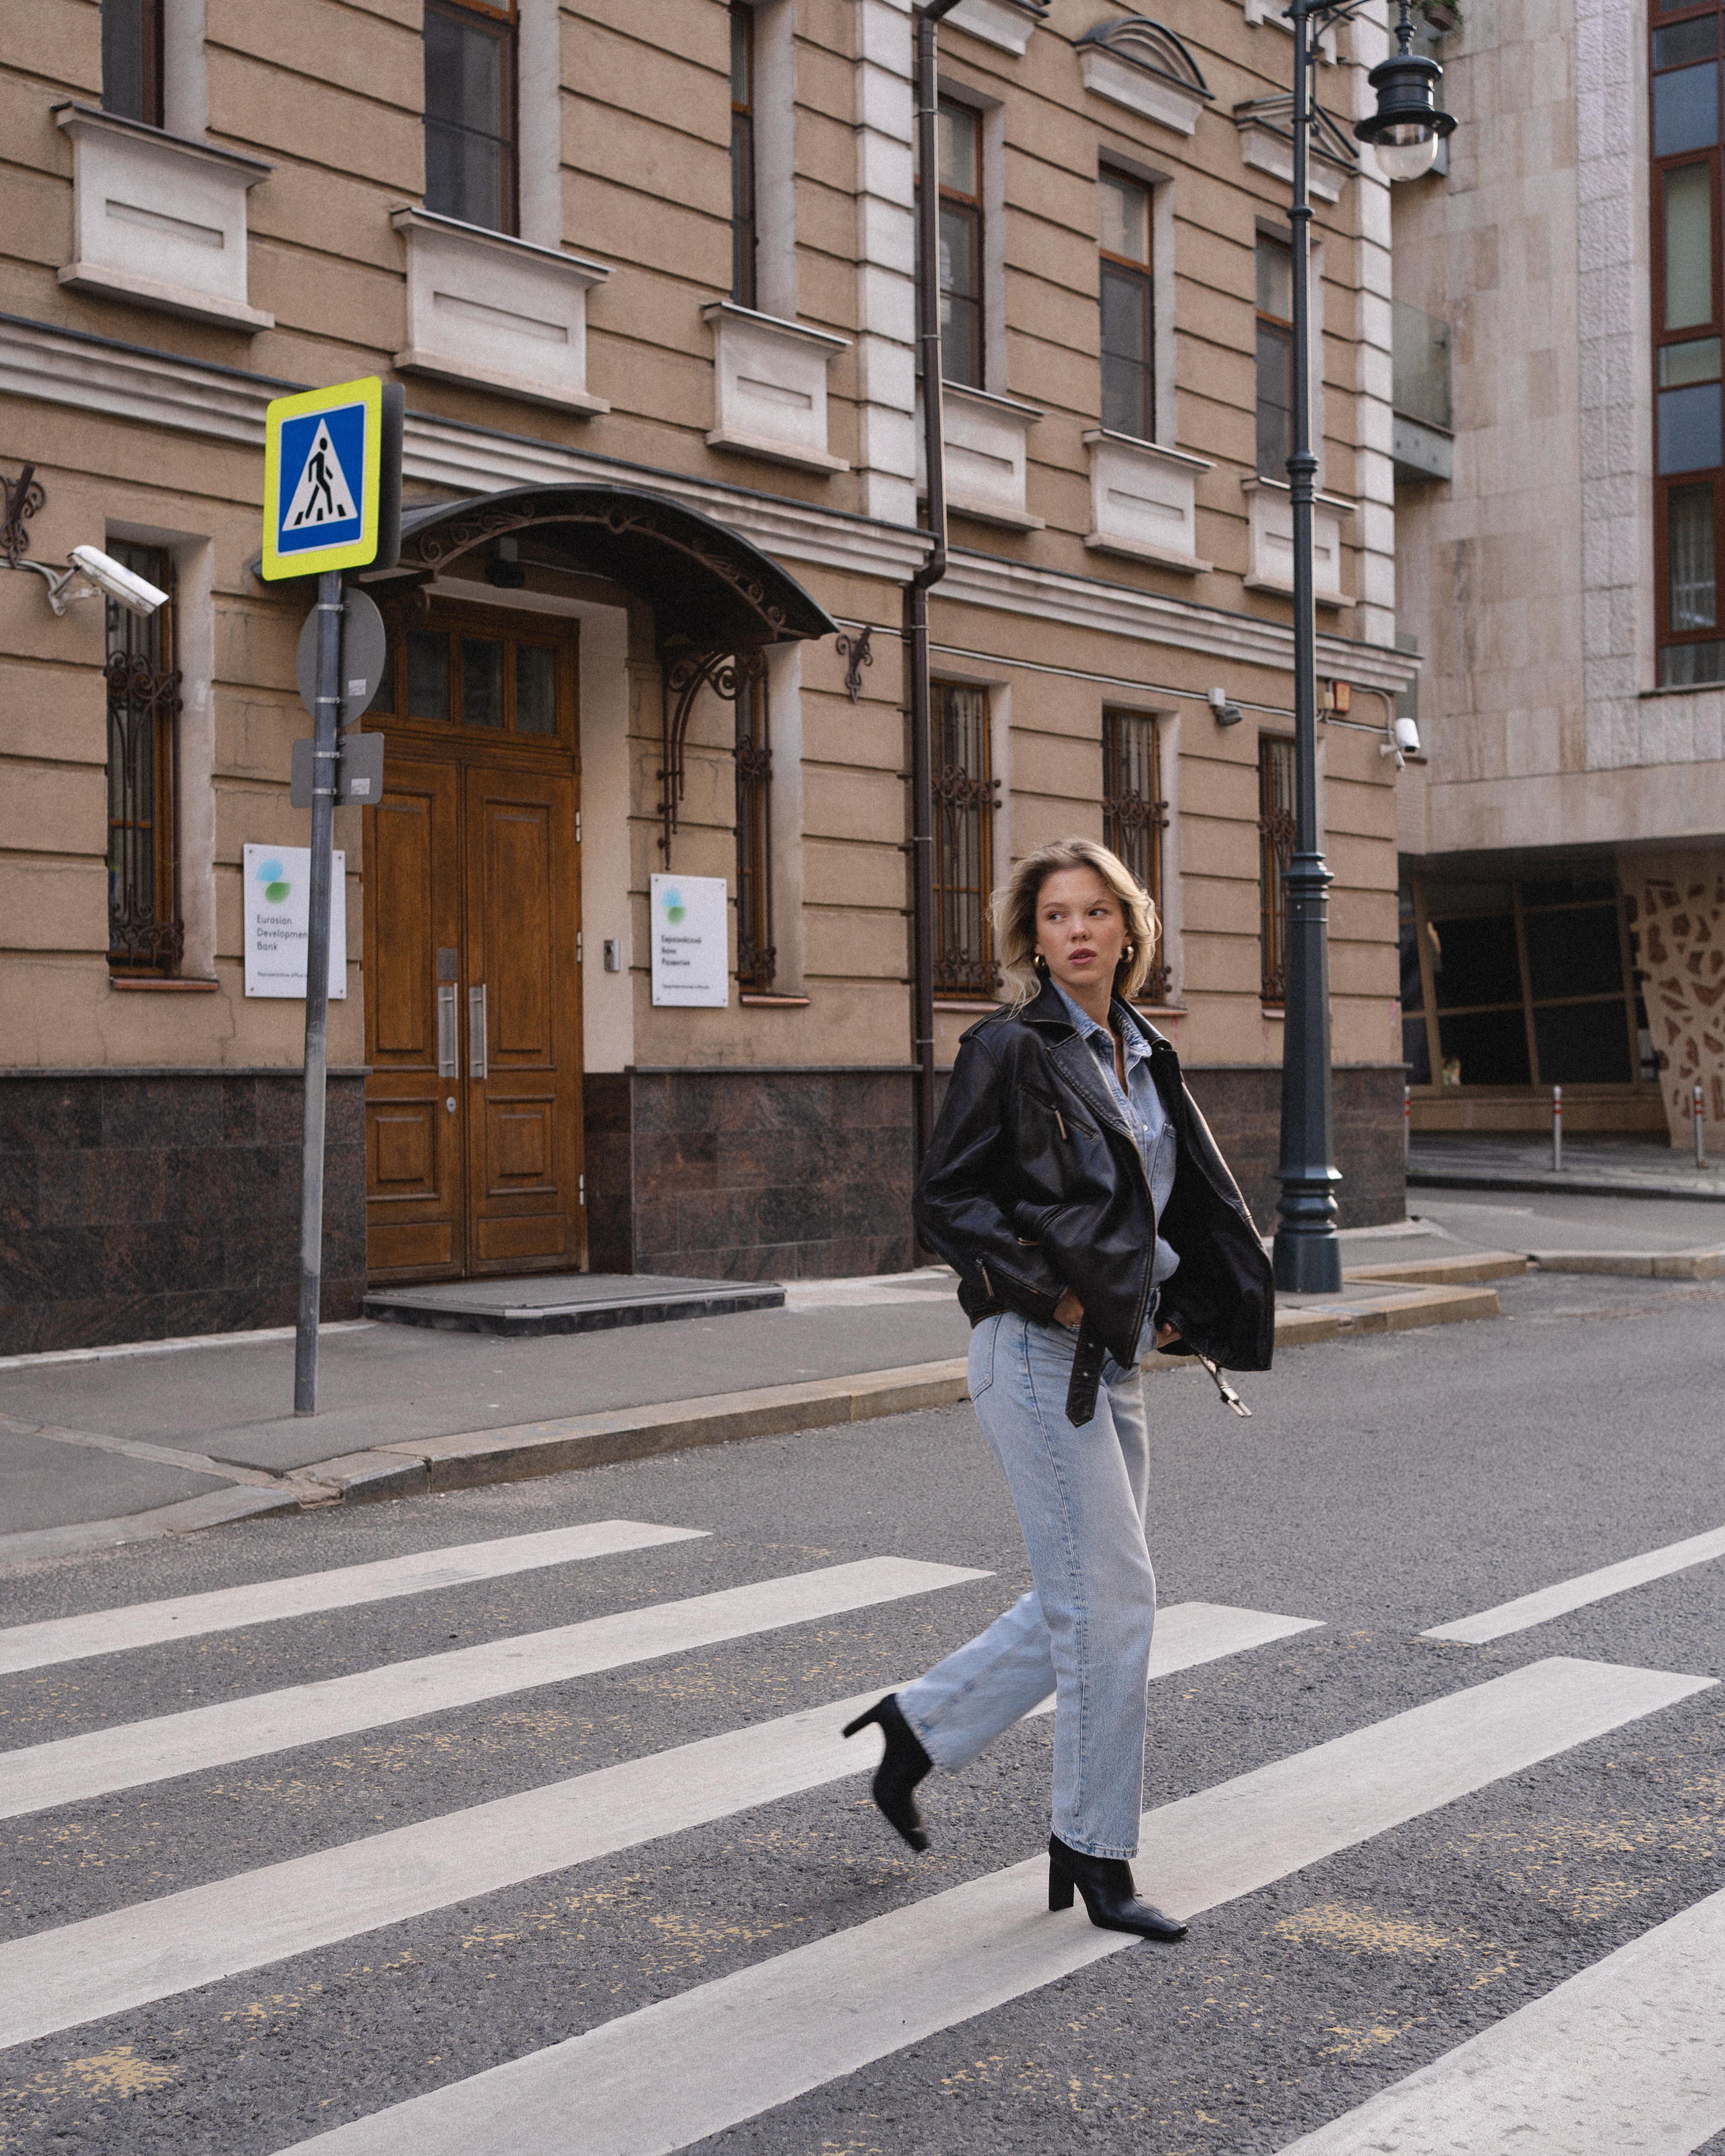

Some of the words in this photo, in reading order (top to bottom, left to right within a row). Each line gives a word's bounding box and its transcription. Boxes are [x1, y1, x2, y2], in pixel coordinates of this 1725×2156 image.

[257, 914, 292, 924] Eurasian
[257, 928, 308, 941] Developmen
[257, 941, 278, 951] Bank
